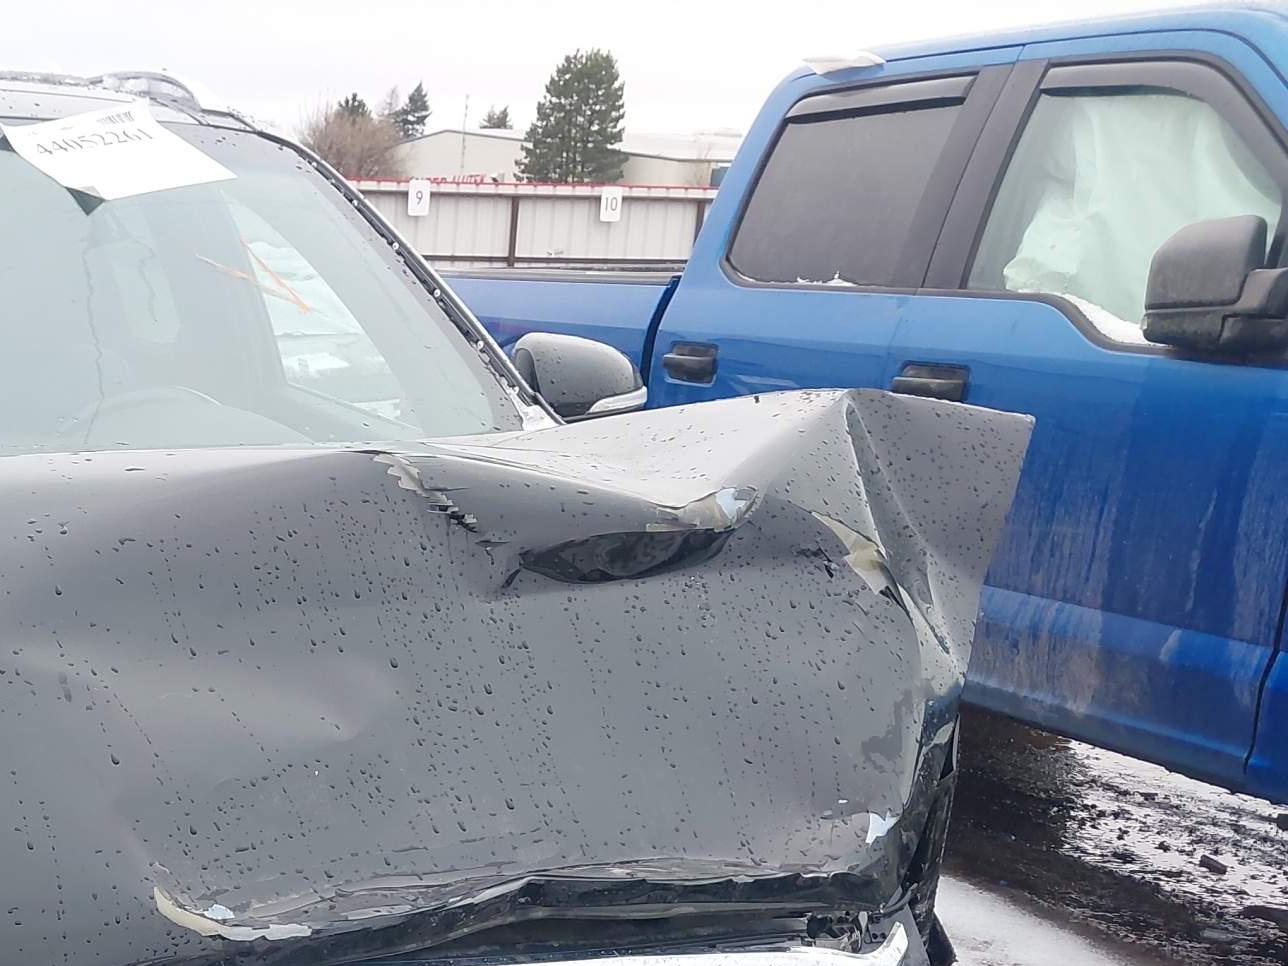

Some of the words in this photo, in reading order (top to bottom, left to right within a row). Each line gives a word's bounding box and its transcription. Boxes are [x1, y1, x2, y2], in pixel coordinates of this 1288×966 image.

[36, 128, 153, 155] 44052261
[415, 190, 424, 205] 9
[604, 196, 618, 212] 10
